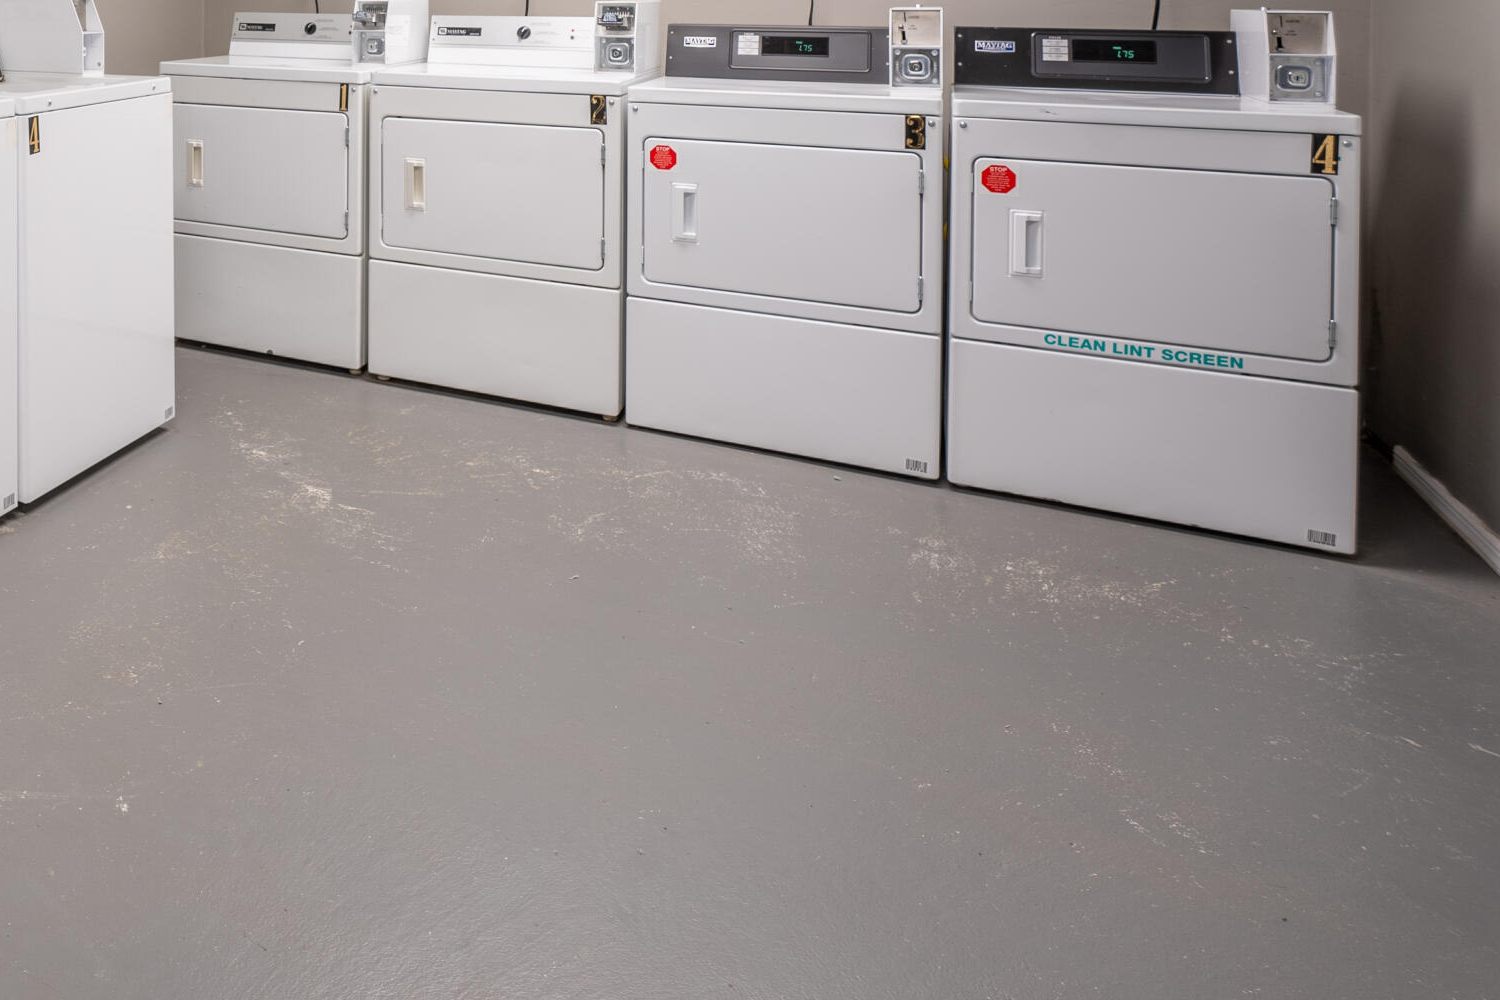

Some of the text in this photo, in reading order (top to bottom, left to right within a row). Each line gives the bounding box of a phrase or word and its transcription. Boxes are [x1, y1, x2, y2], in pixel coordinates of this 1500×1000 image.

[977, 41, 1013, 50] MAYTAG
[341, 84, 348, 110] 1
[592, 96, 606, 124] 2
[29, 117, 40, 152] 4
[907, 116, 924, 148] 3
[1312, 134, 1337, 174] 4
[1044, 333, 1244, 369] CLEAN LINT SCREEN
